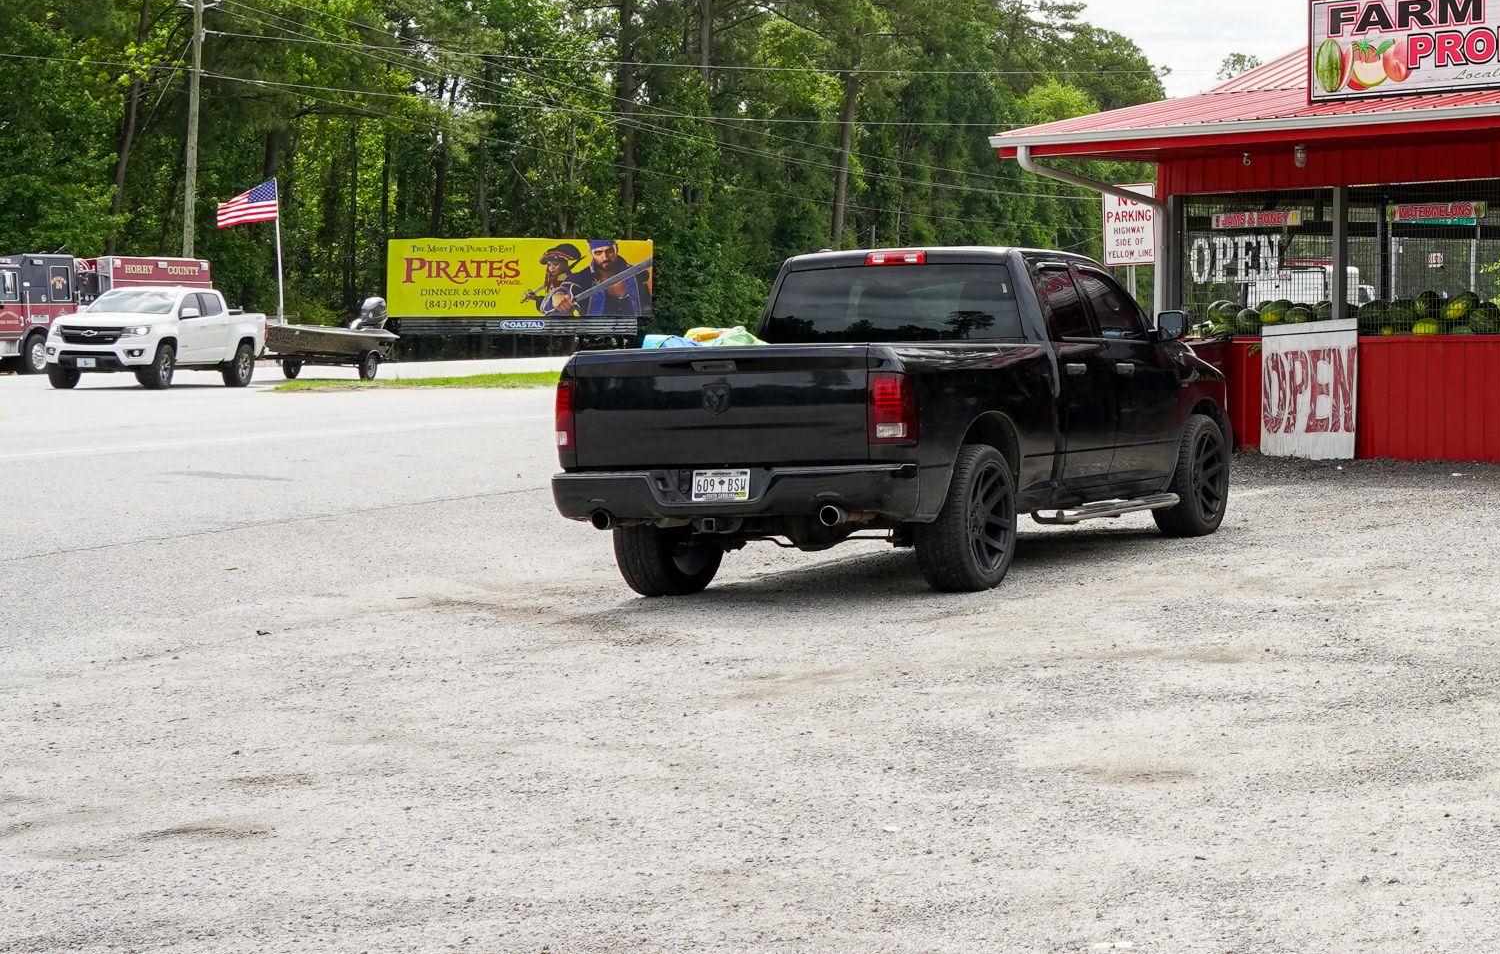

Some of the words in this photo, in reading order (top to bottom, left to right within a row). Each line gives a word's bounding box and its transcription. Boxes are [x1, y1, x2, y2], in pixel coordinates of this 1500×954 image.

[1106, 209, 1152, 224] PARKING
[1399, 202, 1473, 219] WATERMELONS
[1113, 226, 1144, 235] HIGHWAY
[1116, 238, 1132, 246] SIDE
[1108, 250, 1134, 259] YELLOW
[1139, 248, 1153, 257] LINE
[1190, 234, 1280, 285] OPEN
[168, 265, 199, 276] COUNTY
[402, 257, 521, 284] PIRATES
[473, 288, 500, 296] SHOW
[502, 321, 543, 329] COASTAL
[1263, 347, 1357, 434] OPEN
[696, 478, 715, 492] 609
[728, 478, 746, 492] BSW
